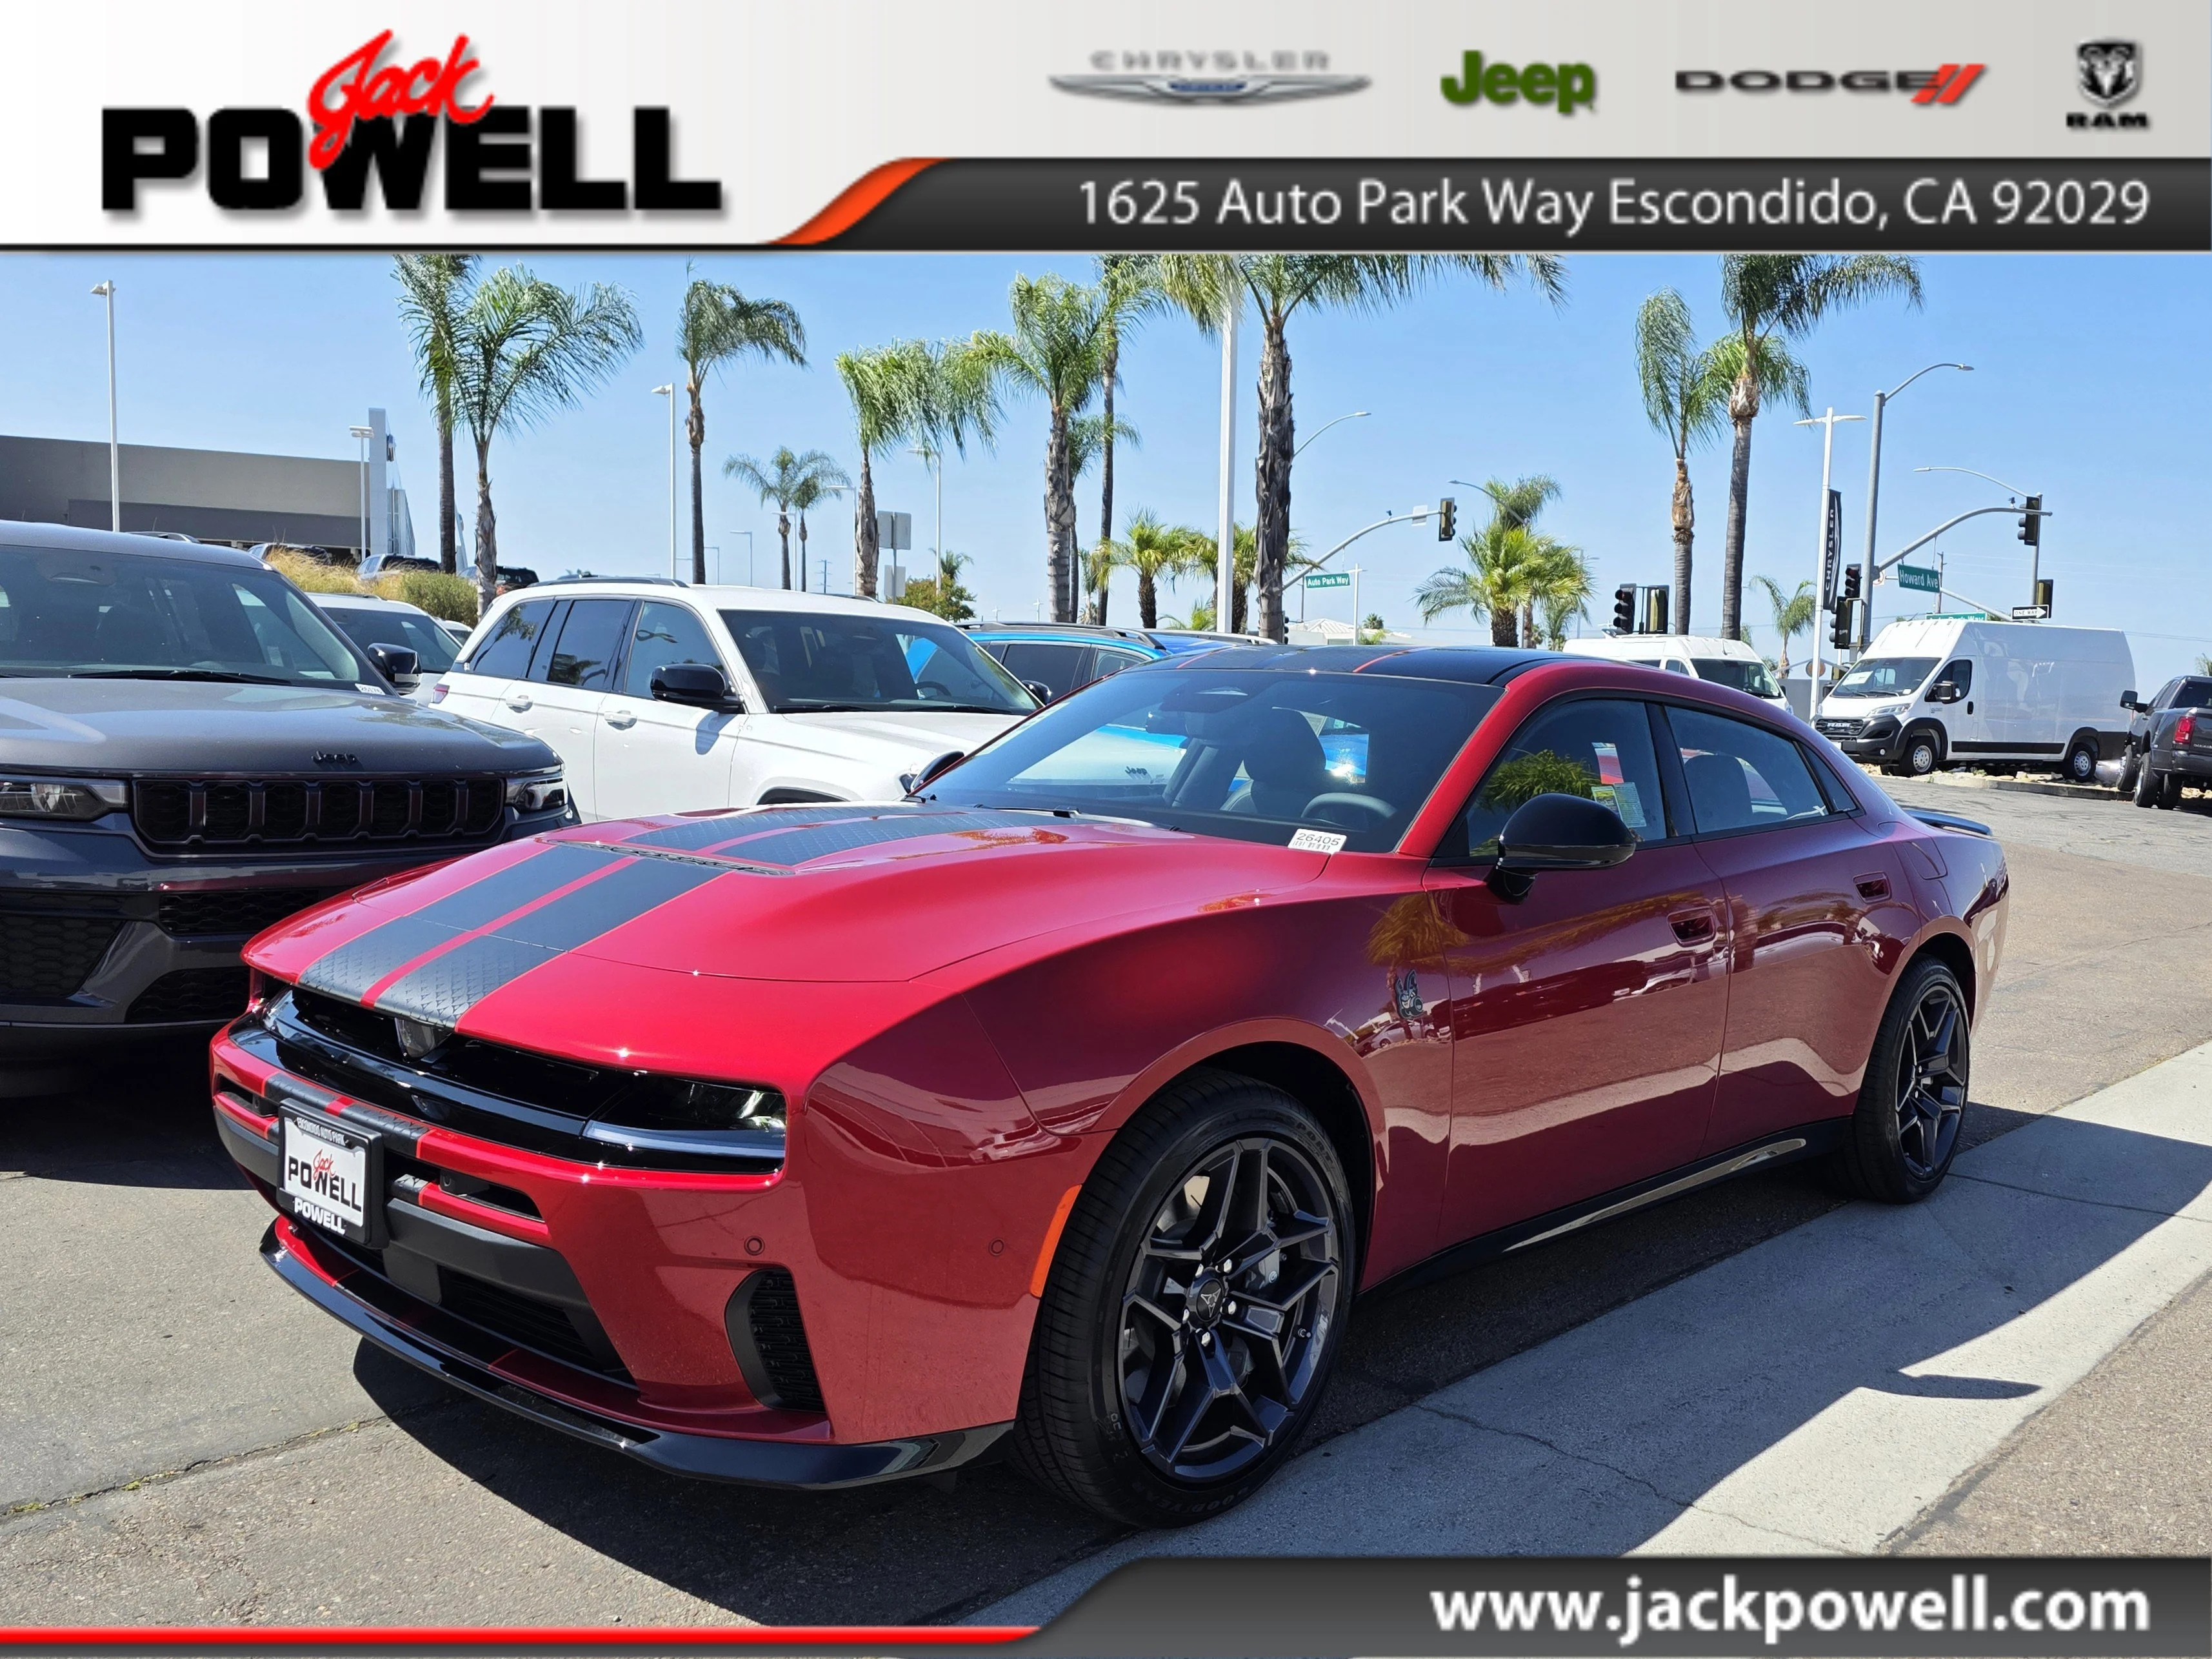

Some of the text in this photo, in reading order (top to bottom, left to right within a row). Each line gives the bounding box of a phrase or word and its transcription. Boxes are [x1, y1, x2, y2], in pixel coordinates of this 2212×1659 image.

[1825, 508, 1834, 591] CHRYSLER
[1307, 576, 1349, 587] Auto Park Way
[1899, 569, 1938, 588] Howard Ave
[311, 750, 357, 765] Jeep
[1297, 832, 1341, 846] 26405
[312, 1148, 337, 1181] Jack
[288, 1155, 362, 1212] POWELL
[294, 1196, 346, 1235] POWELL
